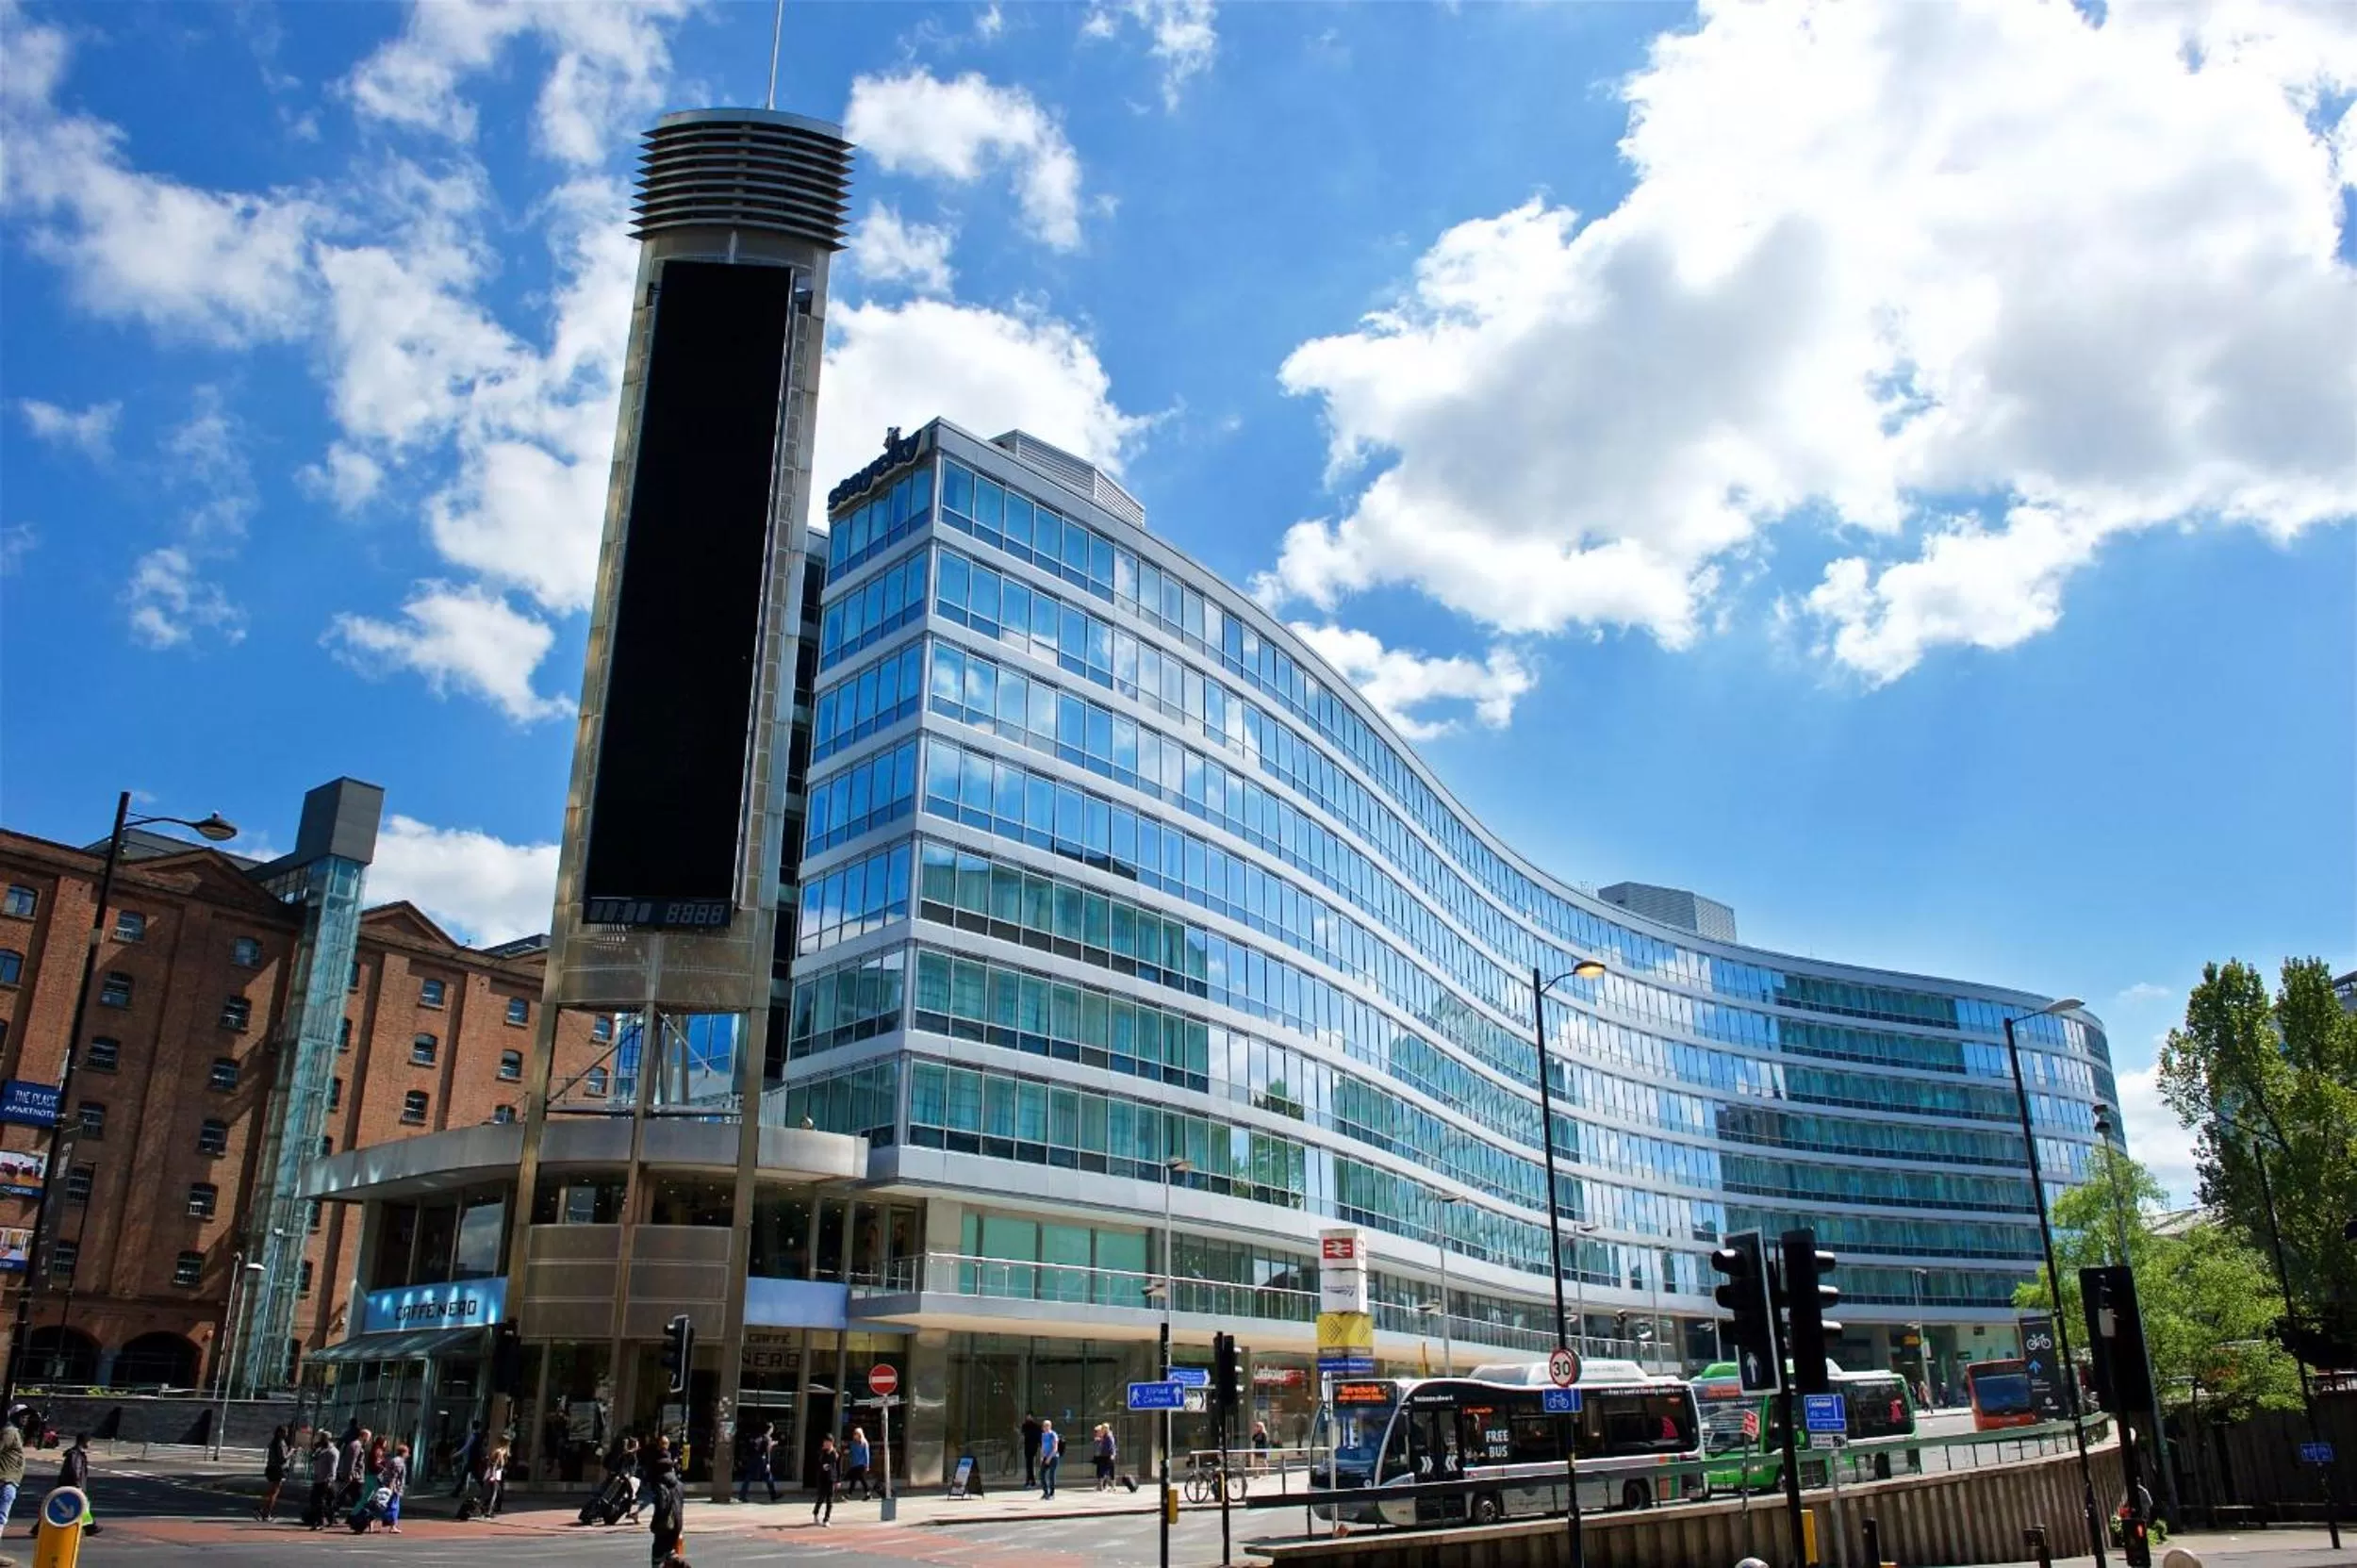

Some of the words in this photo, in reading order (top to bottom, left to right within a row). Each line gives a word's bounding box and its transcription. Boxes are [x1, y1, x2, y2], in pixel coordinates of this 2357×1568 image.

[15, 1089, 31, 1104] THE
[437, 1299, 477, 1318] NERO
[1553, 1361, 1570, 1377] 30
[1485, 1428, 1508, 1443] FREE
[1489, 1444, 1508, 1458] BUS
